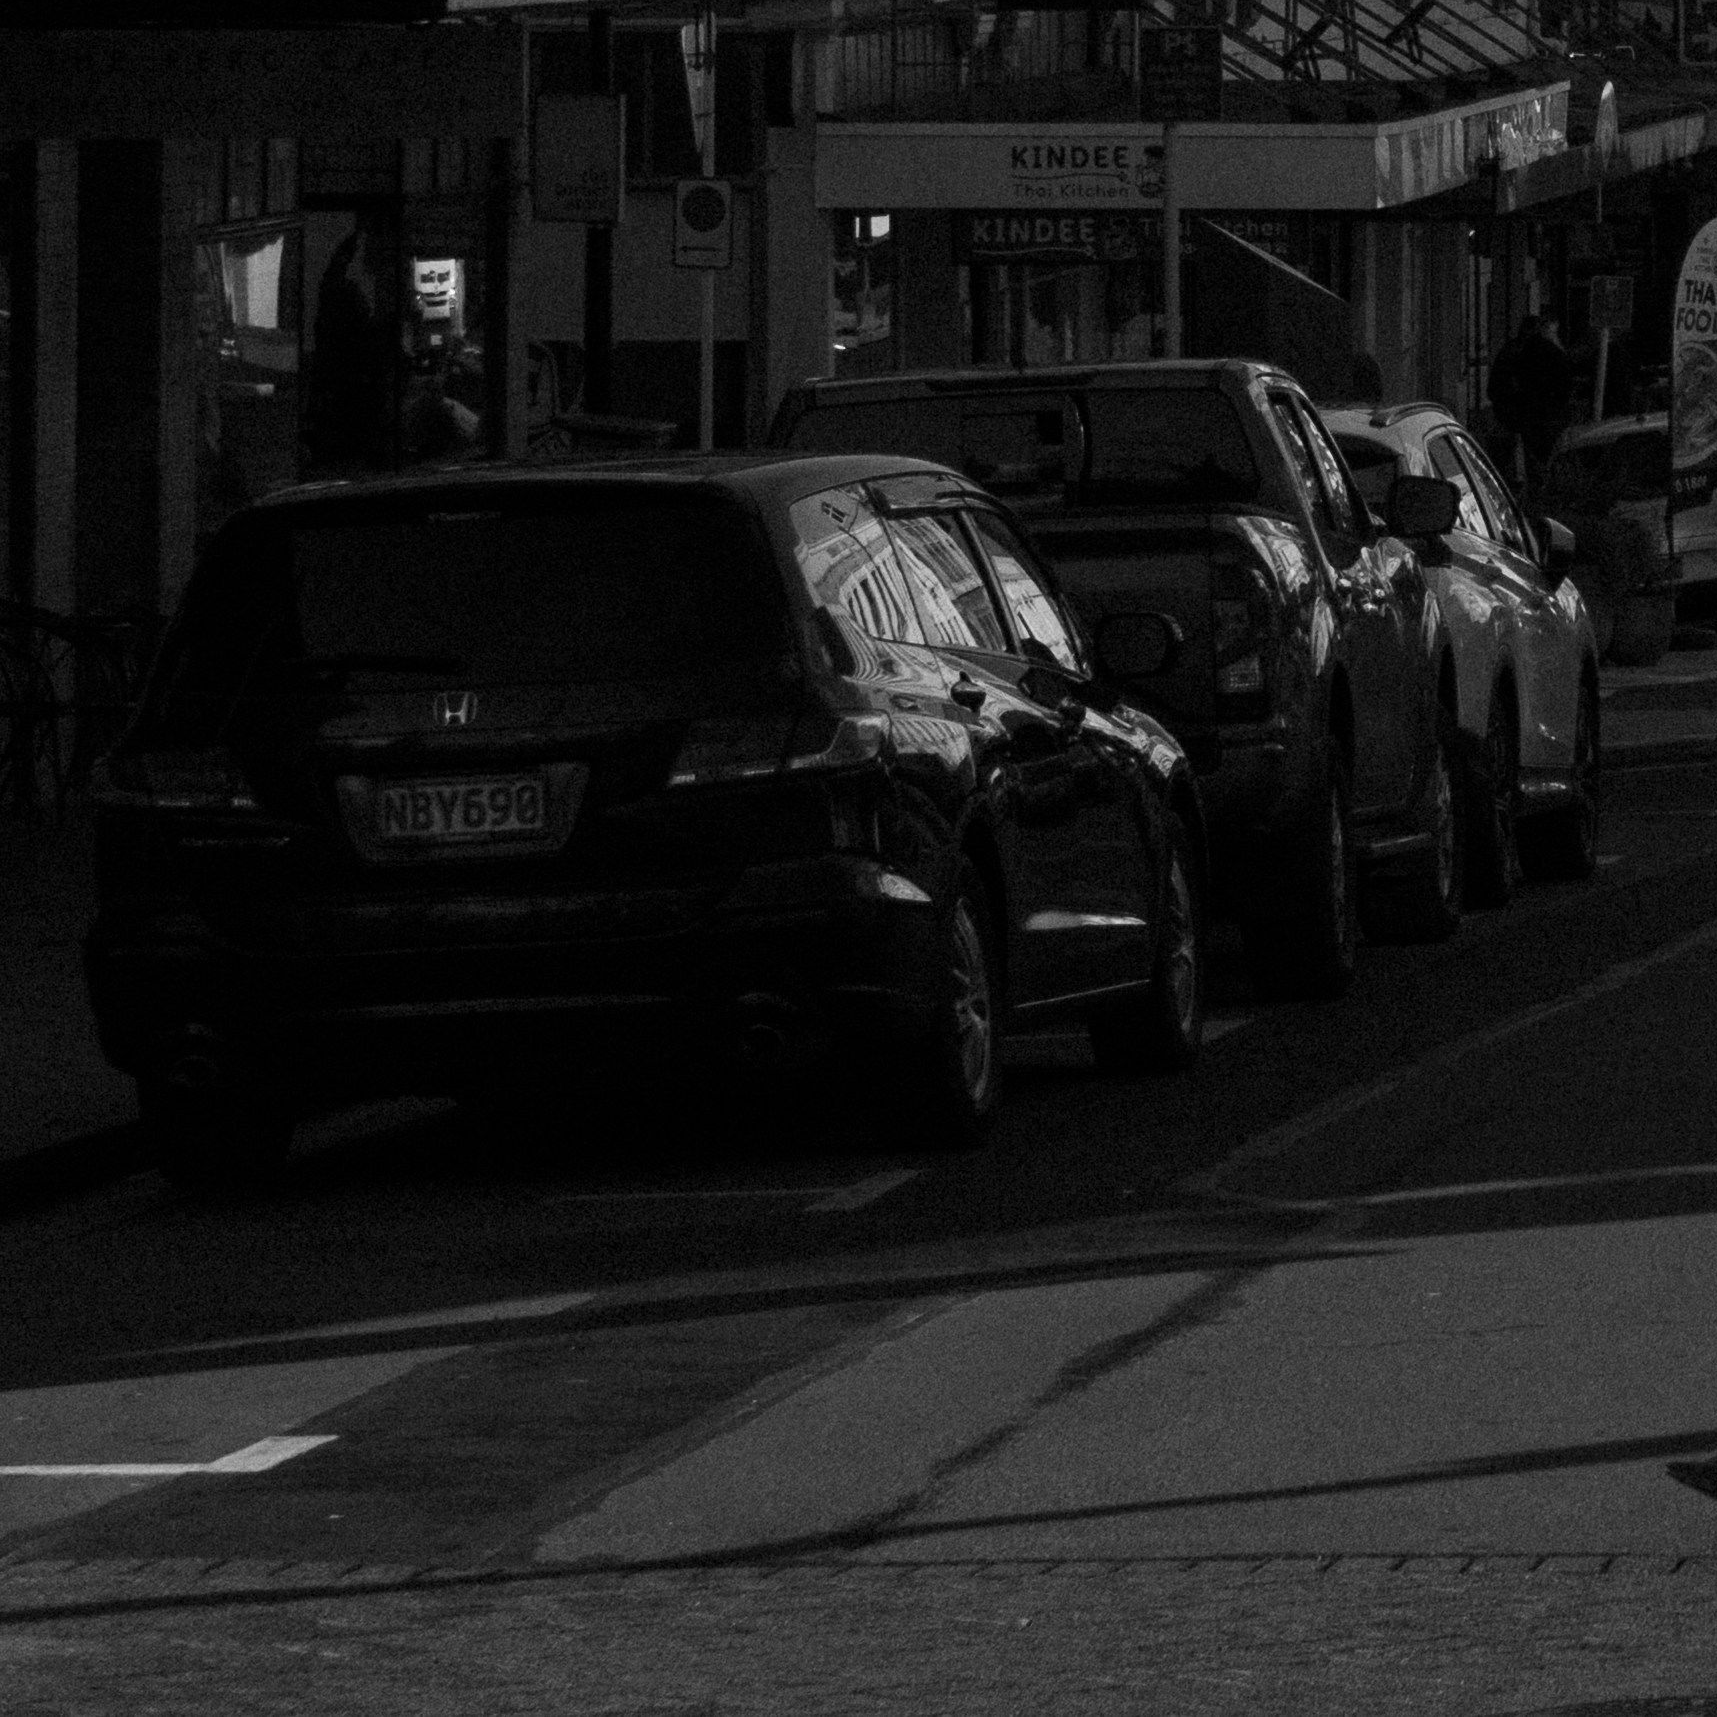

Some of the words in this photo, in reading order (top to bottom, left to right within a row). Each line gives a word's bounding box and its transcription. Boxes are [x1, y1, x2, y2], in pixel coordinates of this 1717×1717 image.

[1011, 145, 1129, 169] KINDEE
[1013, 183, 1057, 198] Thai
[1059, 183, 1128, 199] Kitchen
[972, 216, 1097, 244] KINDEE
[383, 783, 540, 836] NBY690
